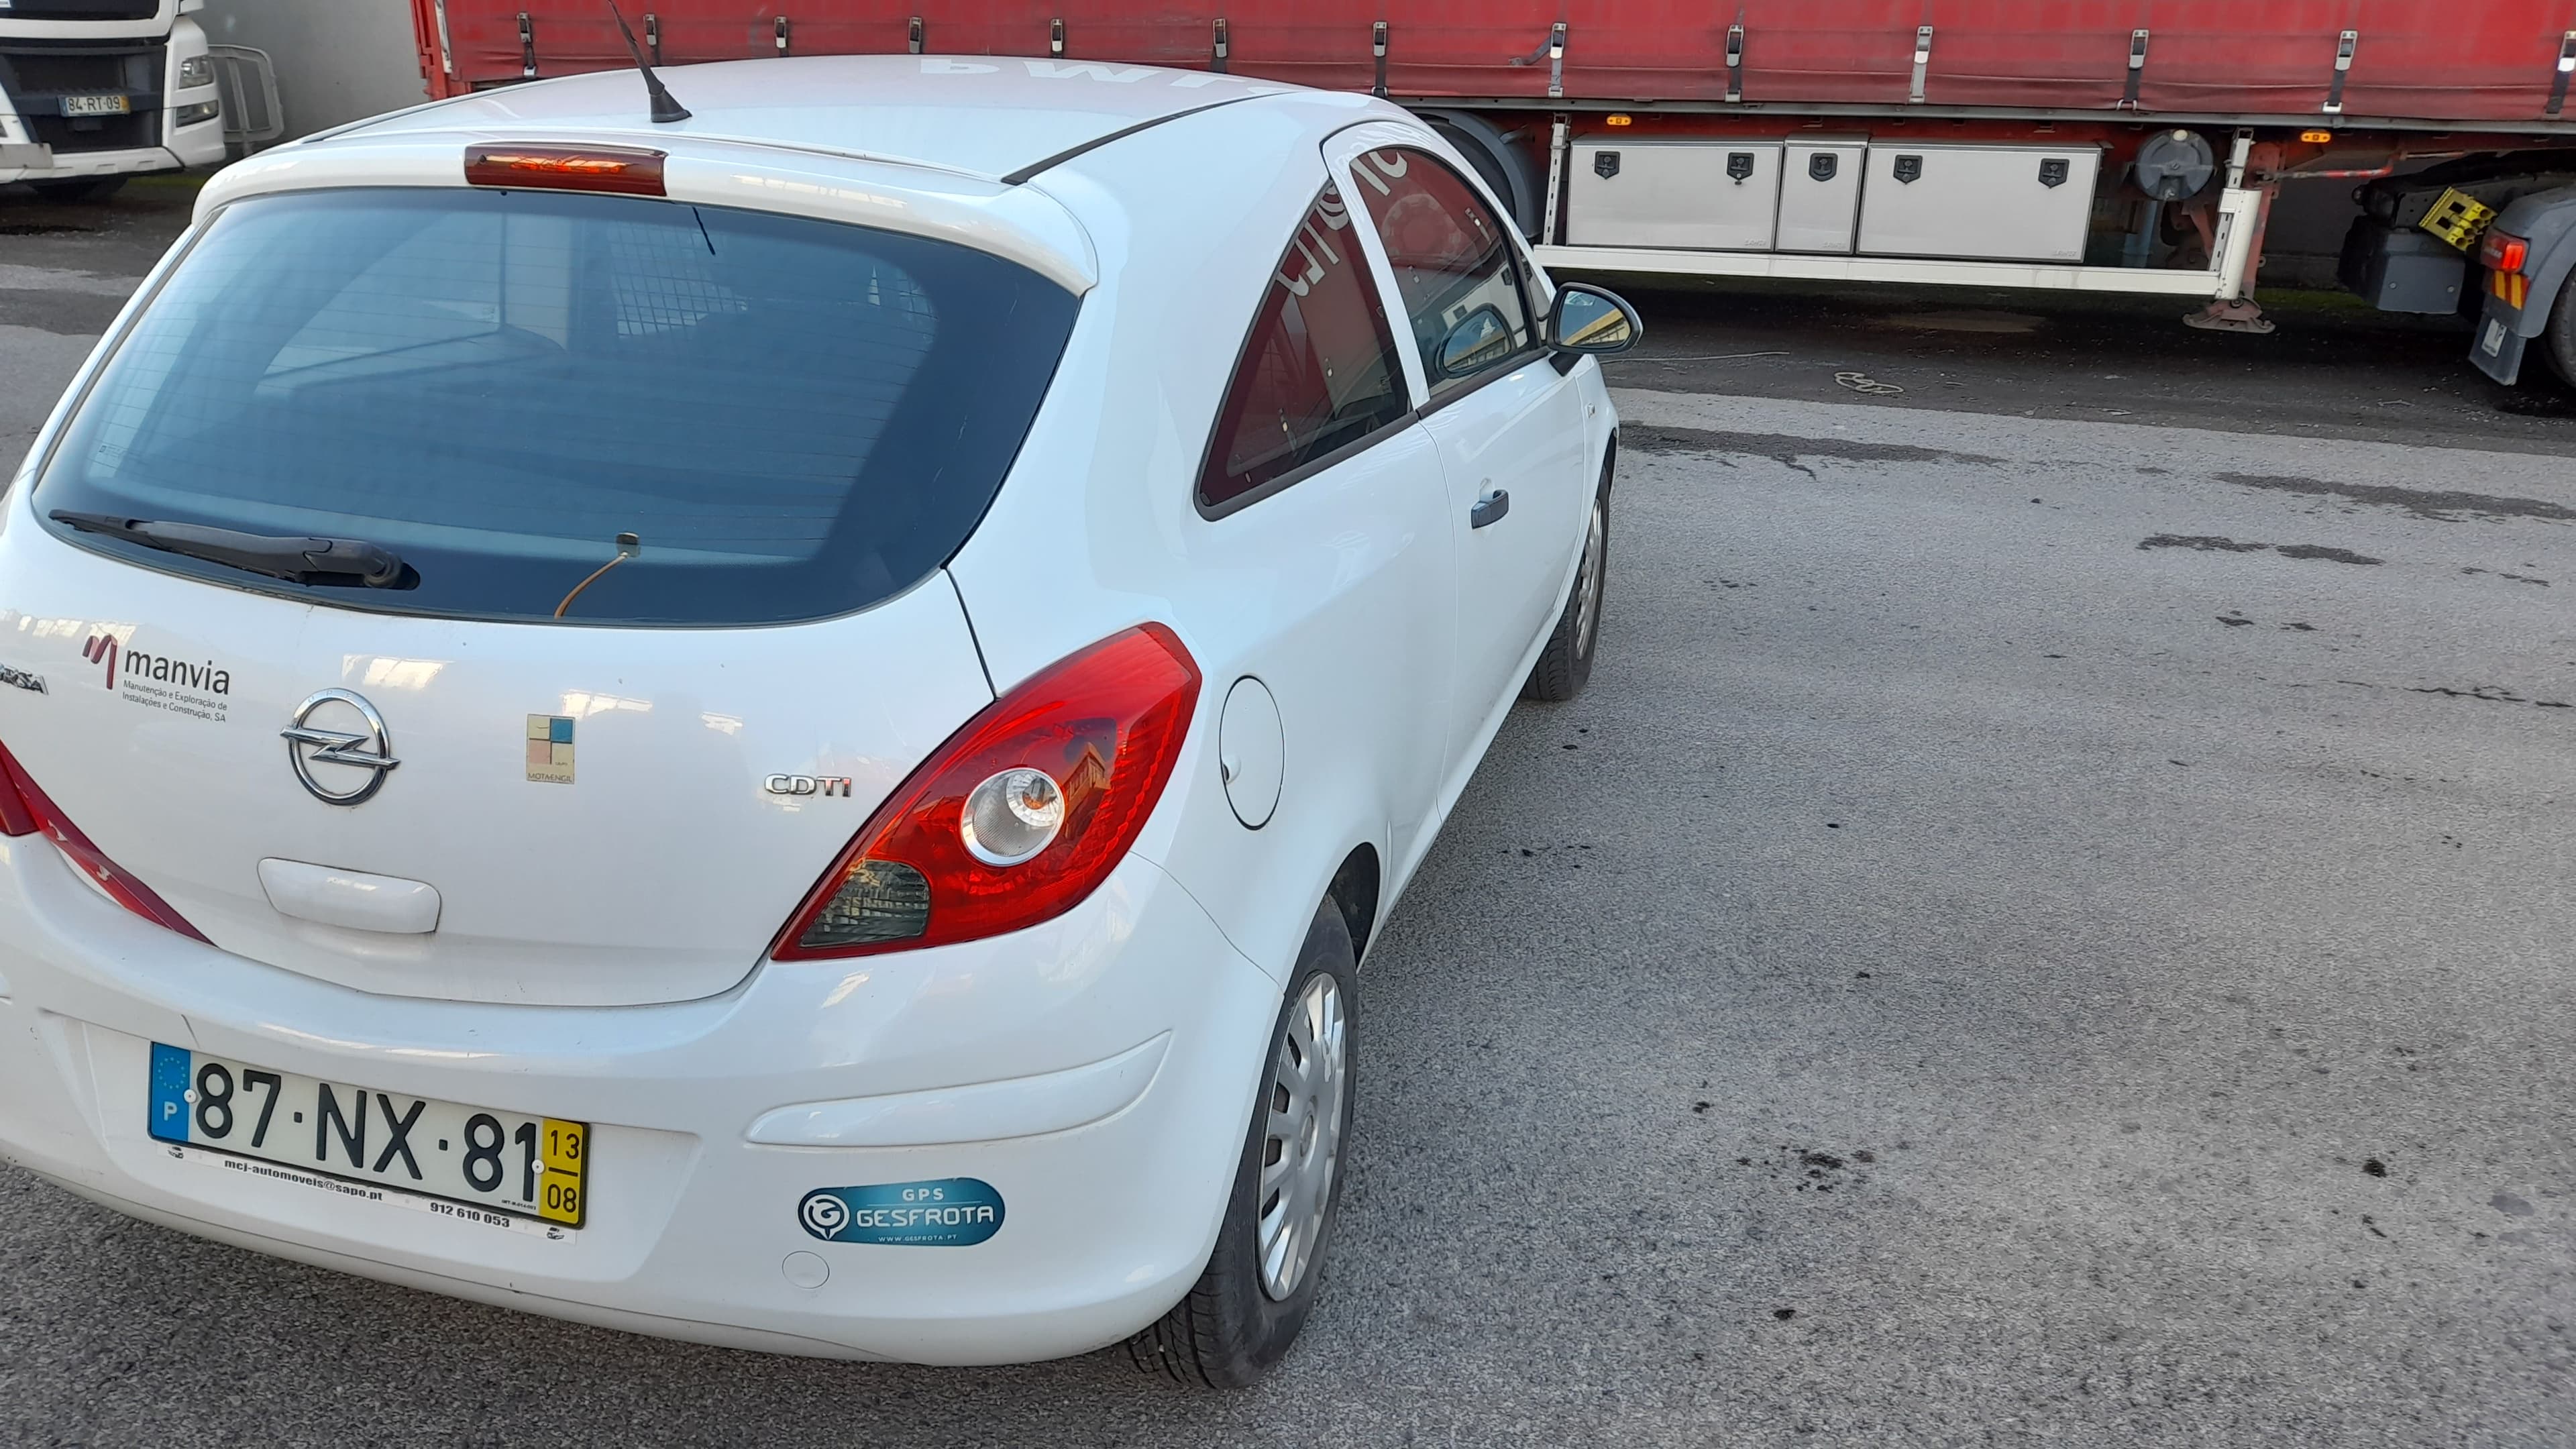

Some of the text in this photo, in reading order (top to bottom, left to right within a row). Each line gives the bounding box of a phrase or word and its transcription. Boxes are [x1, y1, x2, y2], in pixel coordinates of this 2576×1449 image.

[124, 649, 230, 695] manvia
[123, 680, 167, 698] Manutenção
[175, 691, 216, 709] Exploração
[218, 702, 227, 710] de
[214, 712, 227, 722] SA
[764, 773, 852, 797] CDTI
[163, 1102, 178, 1121] P
[549, 1129, 580, 1160] 13
[224, 1159, 383, 1201] mcj-automoveis@sapo.pt
[547, 1183, 577, 1213] 08
[902, 1187, 945, 1201] GPS
[430, 1202, 511, 1228] 912 610 053
[856, 1205, 995, 1228] GESFROTA
